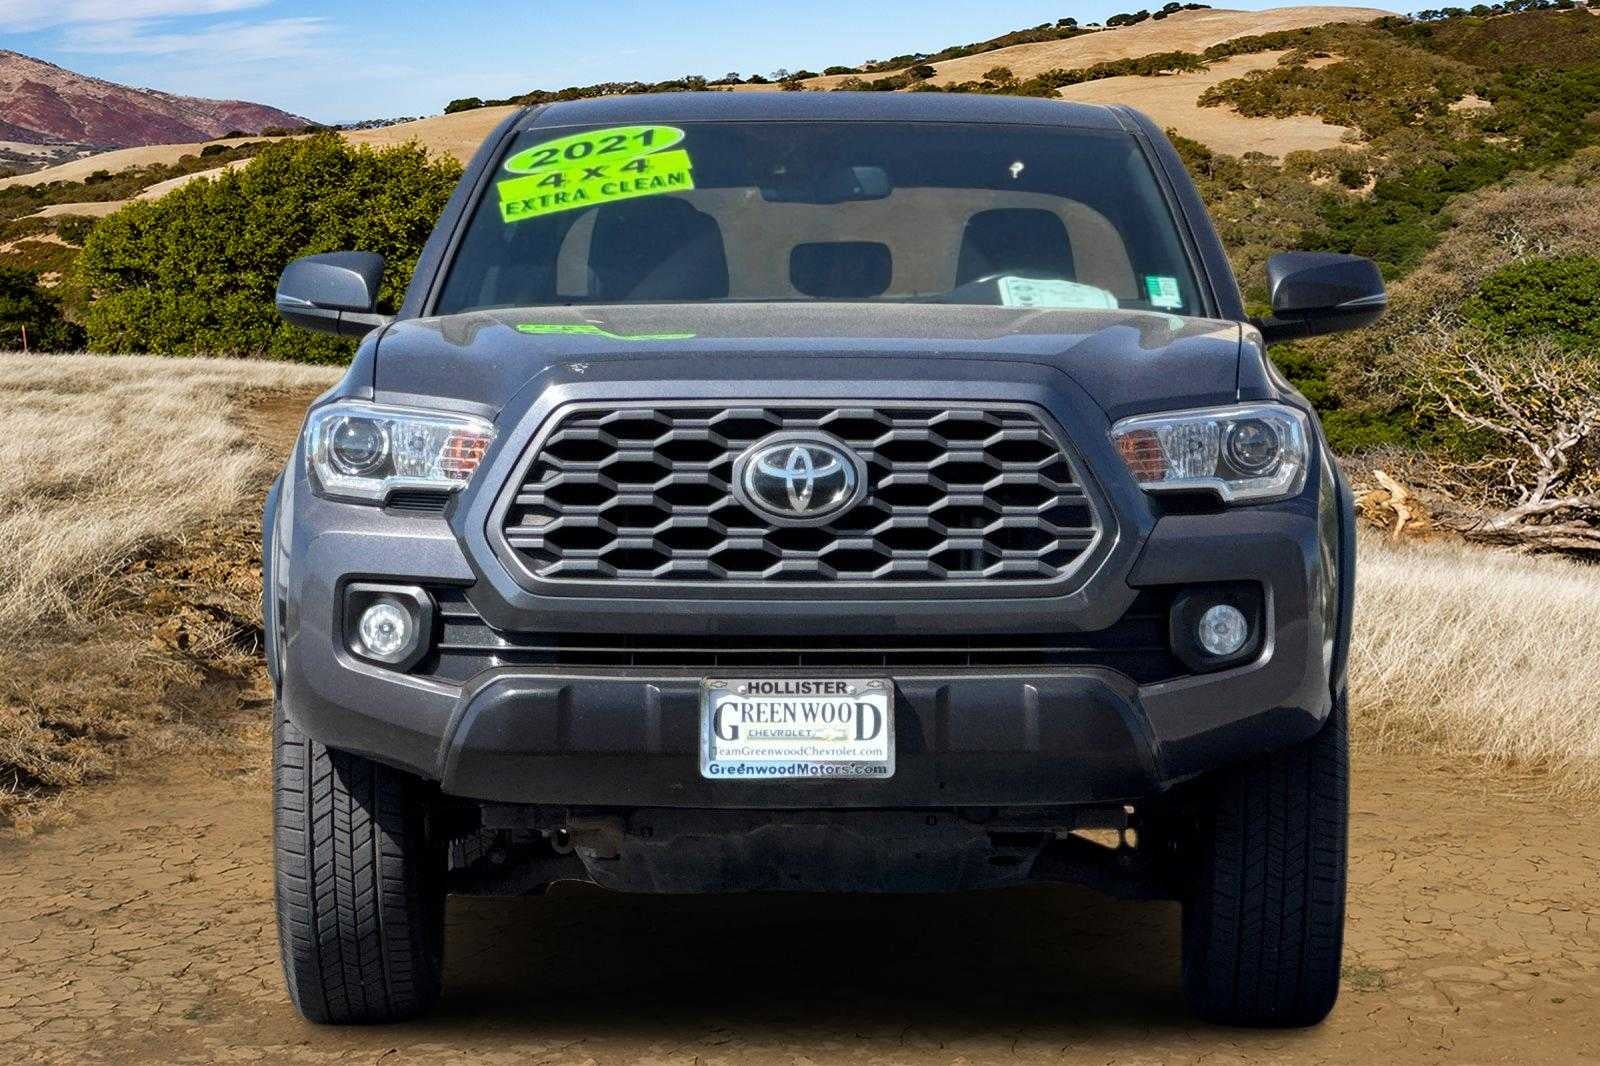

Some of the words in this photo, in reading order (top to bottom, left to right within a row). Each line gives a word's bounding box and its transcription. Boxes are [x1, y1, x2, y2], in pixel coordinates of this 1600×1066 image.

[527, 129, 655, 169] 2021
[537, 172, 566, 188] 4
[620, 158, 650, 173] 4
[505, 188, 588, 215] EXTRA
[600, 172, 685, 195] CLEAN
[747, 682, 848, 694] HOLLISTER
[713, 702, 882, 741] GREENWOOD
[748, 729, 812, 737] CHEVROLET
[709, 763, 887, 775] GreenwoodMotors.com
